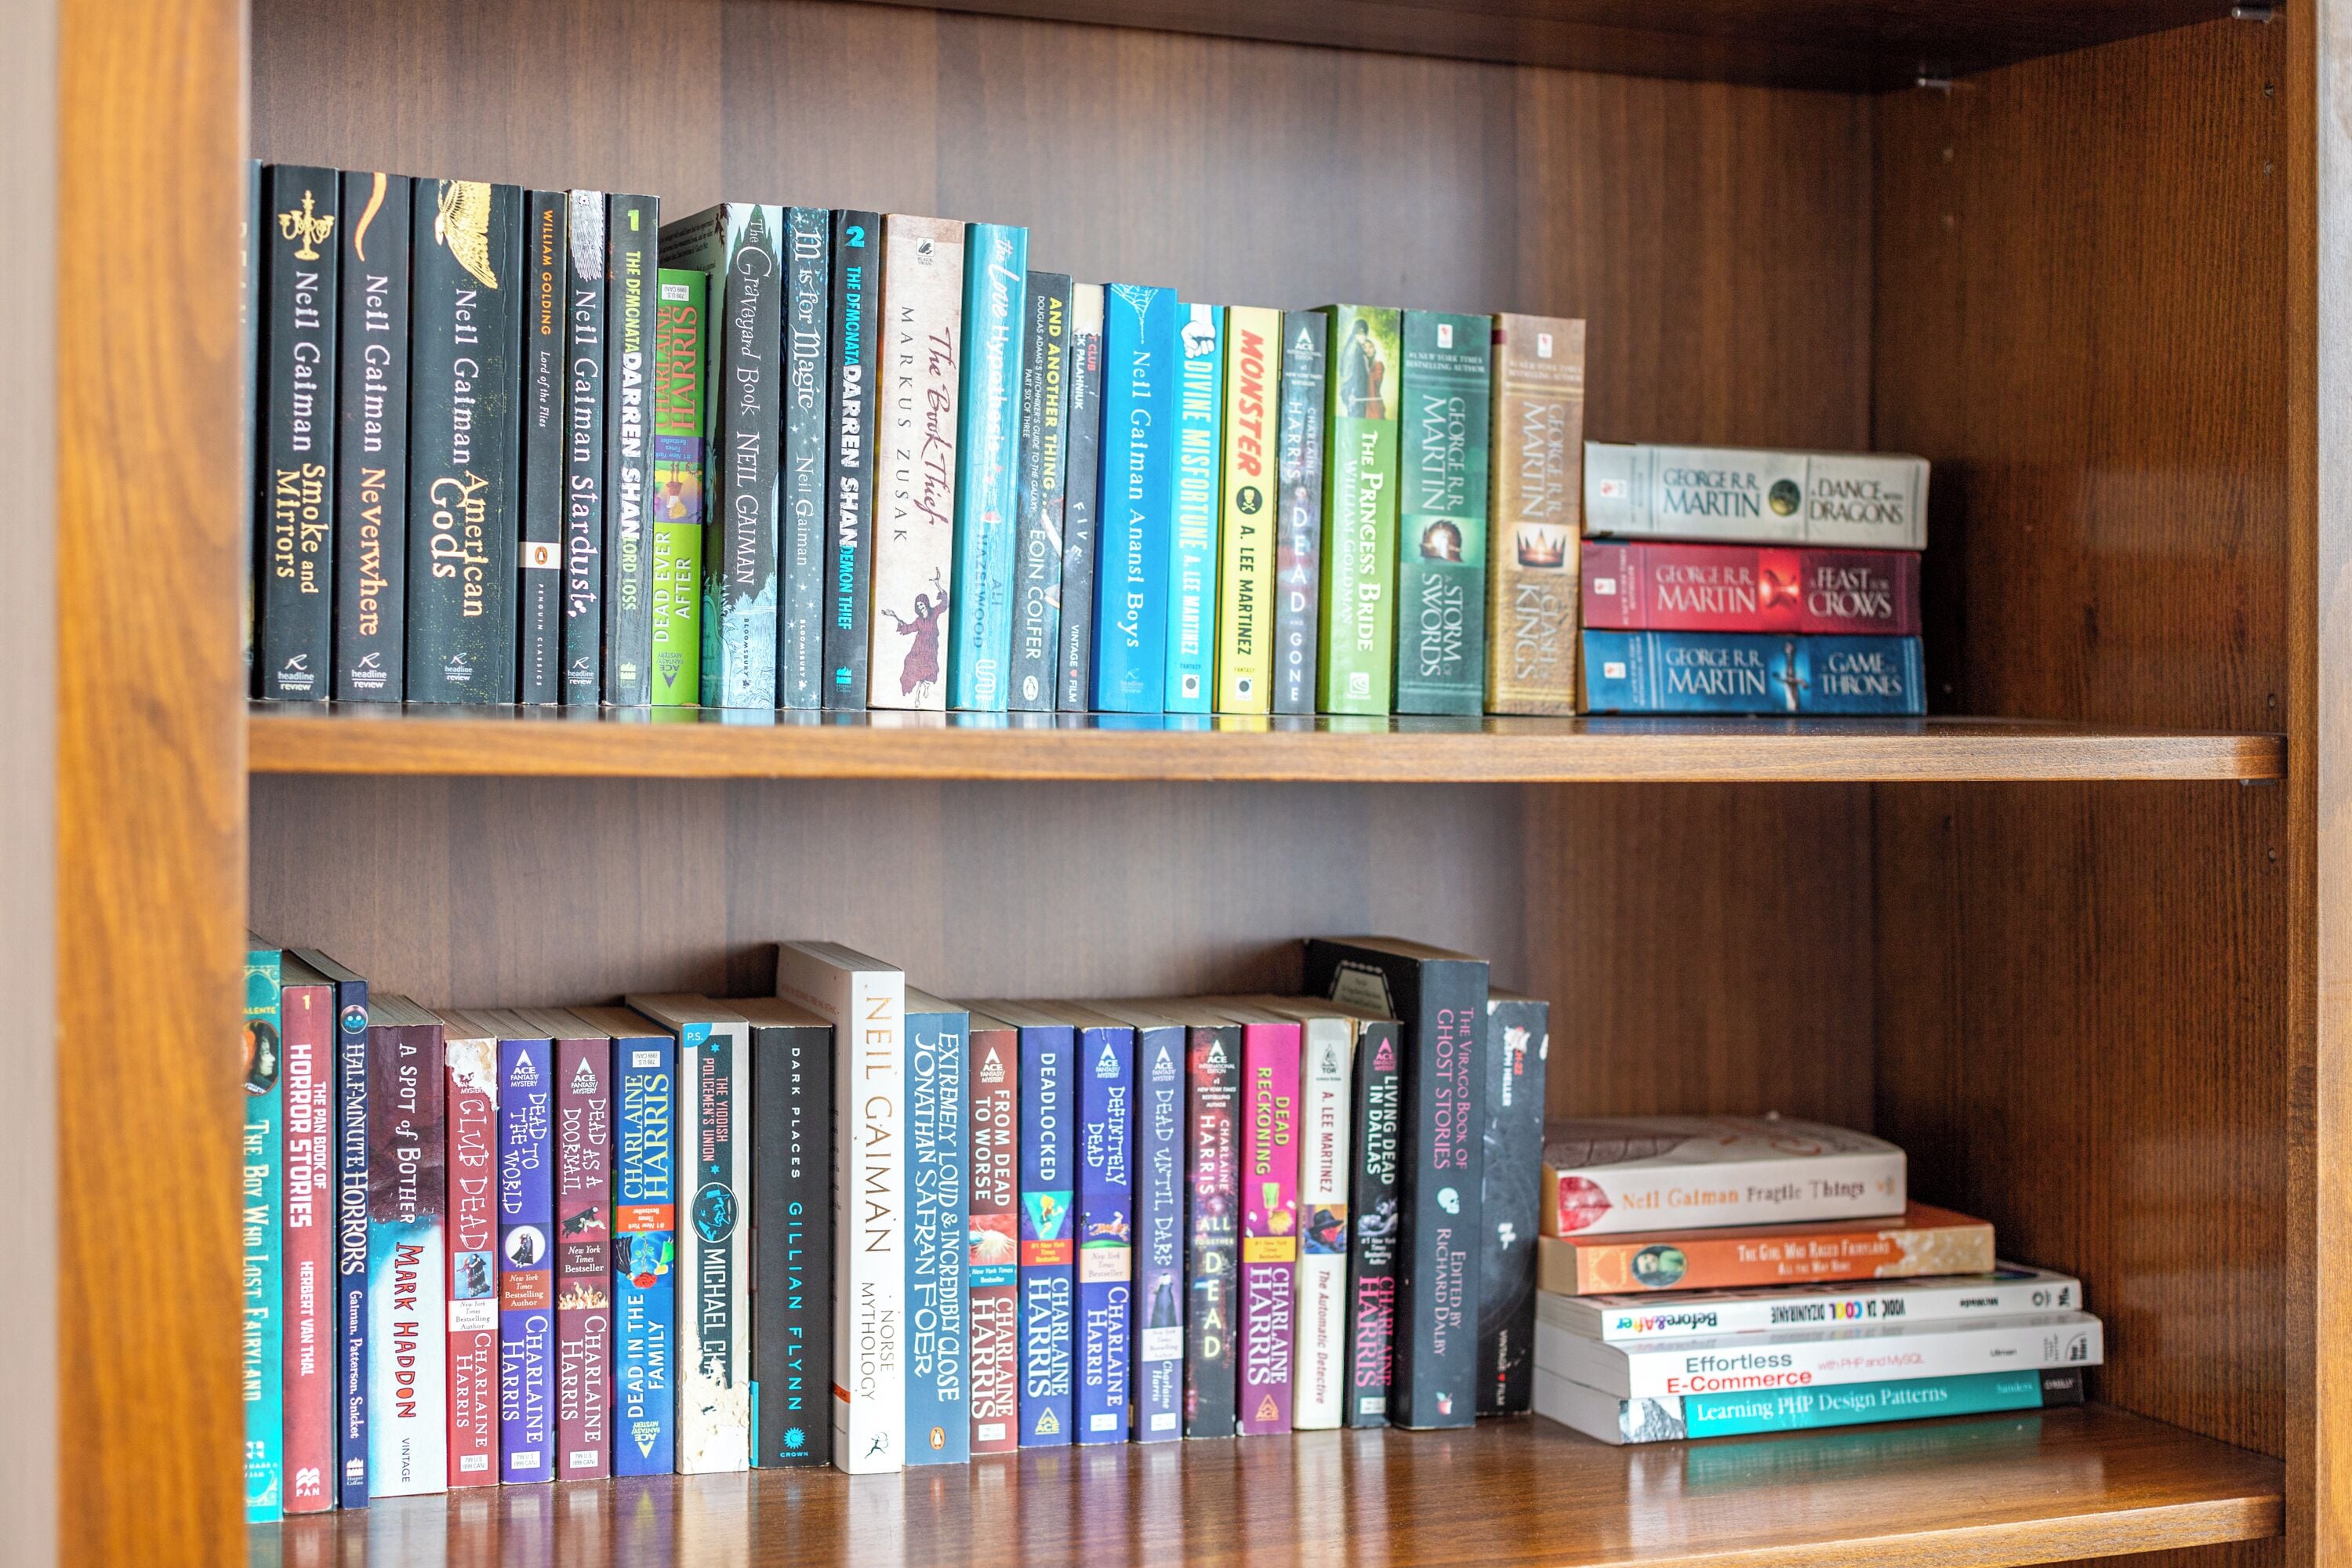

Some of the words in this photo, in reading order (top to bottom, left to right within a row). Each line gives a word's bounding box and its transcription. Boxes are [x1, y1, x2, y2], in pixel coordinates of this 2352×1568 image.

[542, 210, 553, 266] WILLIAM
[750, 219, 762, 243] The
[792, 224, 822, 261] M
[626, 251, 641, 276] THE
[799, 268, 812, 283] is
[295, 272, 320, 328] Neil
[455, 289, 478, 345] Neil
[541, 272, 552, 335] GOLDING
[625, 278, 641, 354] DEMONATA
[735, 246, 771, 360] Graveyard
[799, 287, 818, 324] for
[1049, 297, 1062, 336] AND
[537, 376, 550, 388] of
[540, 351, 550, 373] Lord
[671, 307, 697, 429] HARRIS
[790, 324, 821, 413] Magic
[897, 307, 915, 427] MARKUS
[928, 327, 956, 376] The
[1074, 349, 1085, 409] PALAHNIUK
[1132, 350, 1151, 398] Neil
[293, 343, 321, 451] Gaiman
[453, 358, 479, 464] Gaiman
[539, 389, 550, 403] the
[622, 353, 642, 457] DARREN
[736, 366, 760, 416] Book
[1024, 402, 1031, 414] OF
[1046, 343, 1061, 427] ANOTHER
[1183, 361, 1212, 422] DIVINE
[1238, 329, 1265, 477] MONSTER
[539, 406, 549, 427] Flies
[921, 384, 952, 459] Book
[736, 431, 760, 488] NEIL
[1129, 409, 1151, 500] Gaiman
[1360, 430, 1378, 466] THE
[1421, 394, 1446, 511] MARTIN
[300, 463, 329, 552] Smoke
[621, 468, 641, 539] SHAN
[894, 449, 910, 543] ZUSAK
[913, 453, 950, 525] Thief
[1179, 429, 1210, 550] MISFORTUNE
[1664, 492, 1760, 517] MARTIN
[1809, 500, 1904, 524] DRAGONS
[276, 470, 300, 577] Mirrors
[360, 468, 388, 636] Neverwhere
[430, 477, 469, 578] Gods
[463, 470, 489, 617] American
[569, 475, 598, 614] Stardust
[736, 494, 759, 586] GAIMAN
[1127, 509, 1145, 583] Anansi
[1240, 525, 1254, 539] A.
[1358, 471, 1383, 575] PRINCESS
[301, 561, 318, 593] and
[655, 532, 671, 582] EVER
[838, 546, 853, 591] DEMON
[1029, 530, 1045, 579] EOIN
[1240, 547, 1254, 572] LEE
[654, 589, 670, 641] DEAD
[674, 558, 691, 619] AFTER
[837, 597, 853, 630] THIEF
[1238, 579, 1253, 655] MARTINEZ
[1357, 583, 1381, 652] BRIDE
[1809, 591, 1891, 618] CROWS
[1025, 587, 1044, 659] COLFER
[1117, 592, 1144, 648] Boys
[1420, 573, 1443, 677] SWORDS
[278, 671, 314, 681] headline
[1821, 673, 1902, 695] THRONES
[399, 1044, 417, 1058] A
[687, 1033, 704, 1041] P.S.
[866, 997, 892, 1080] NEIL
[1436, 1009, 1454, 1082] GHOST
[290, 1044, 311, 1133] HORROR
[343, 1043, 365, 1167] HALF-MINUTE
[398, 1066, 417, 1113] SPOT
[529, 1093, 547, 1139] DEAD
[702, 1058, 714, 1125] POLICEMEN'S
[717, 1076, 728, 1096] THE
[914, 1033, 936, 1163] JONATHAN
[938, 1033, 959, 1147] EXTREMELY
[1040, 1053, 1056, 1181] DEADLOCKED
[244, 1119, 270, 1156] THE
[396, 1120, 418, 1140] of
[458, 1099, 488, 1167] CLUB
[510, 1108, 528, 1145] THE
[561, 1108, 582, 1196] DOORNAIL
[702, 1129, 714, 1162] UNION
[717, 1101, 728, 1142] YIDDISH
[791, 1107, 800, 1178] PLACES
[1105, 1086, 1127, 1185] DEFINITELY
[1256, 1068, 1272, 1176] RECKONING
[1367, 1110, 1382, 1174] DALLAS
[1434, 1088, 1453, 1169] STORIES
[243, 1163, 270, 1197] BOY
[290, 1141, 312, 1228] STORIES
[397, 1148, 421, 1224] BOTHER
[503, 1152, 522, 1214] WORLD
[522, 1142, 539, 1170] TO
[865, 1096, 893, 1252] GAIMAN
[938, 1152, 958, 1207] LOUD
[243, 1204, 269, 1245] WHO
[340, 1173, 368, 1275] HORRORS
[459, 1177, 488, 1250] DEAD
[914, 1169, 937, 1276] SAFRAN
[941, 1212, 958, 1227] &
[1622, 1191, 1660, 1210] Neil
[1668, 1187, 1739, 1209] Gaiman
[243, 1255, 268, 1298] LOST
[394, 1242, 425, 1312] MARK
[564, 1264, 604, 1273] Bestseller
[568, 1247, 585, 1255] New
[586, 1246, 601, 1254] York
[789, 1202, 803, 1308] GILLIAN
[1436, 1229, 1451, 1303] RICHARD
[300, 1261, 314, 1316] HERBERT
[704, 1249, 726, 1334] MICHAEL
[939, 1230, 960, 1334] INCREDIBLY
[243, 1307, 269, 1401] FAIRYLAND
[300, 1318, 314, 1345] VAN
[648, 1321, 664, 1390] FAMILY
[861, 1282, 876, 1400] MYTHOLOGY
[880, 1310, 895, 1372] NORSE
[914, 1282, 937, 1377] FOER
[1434, 1308, 1449, 1356] DALBY
[300, 1346, 314, 1376] THAL
[394, 1322, 419, 1417] HADDON
[503, 1339, 524, 1421] HARRIS
[525, 1316, 548, 1443] CHARLAINE
[788, 1327, 802, 1410] FLYNN
[937, 1337, 960, 1403] CLOSE
[1668, 1371, 1812, 1394] E-Commerce
[1686, 1353, 1792, 1374] Effortless
[350, 1397, 363, 1439] Snicket
[1697, 1399, 1774, 1423] Learning
[1778, 1396, 1813, 1414] PHP
[1819, 1389, 1876, 1413] Design
[1882, 1386, 1948, 1406] Patterns
[401, 1438, 410, 1483] VINTAGE
